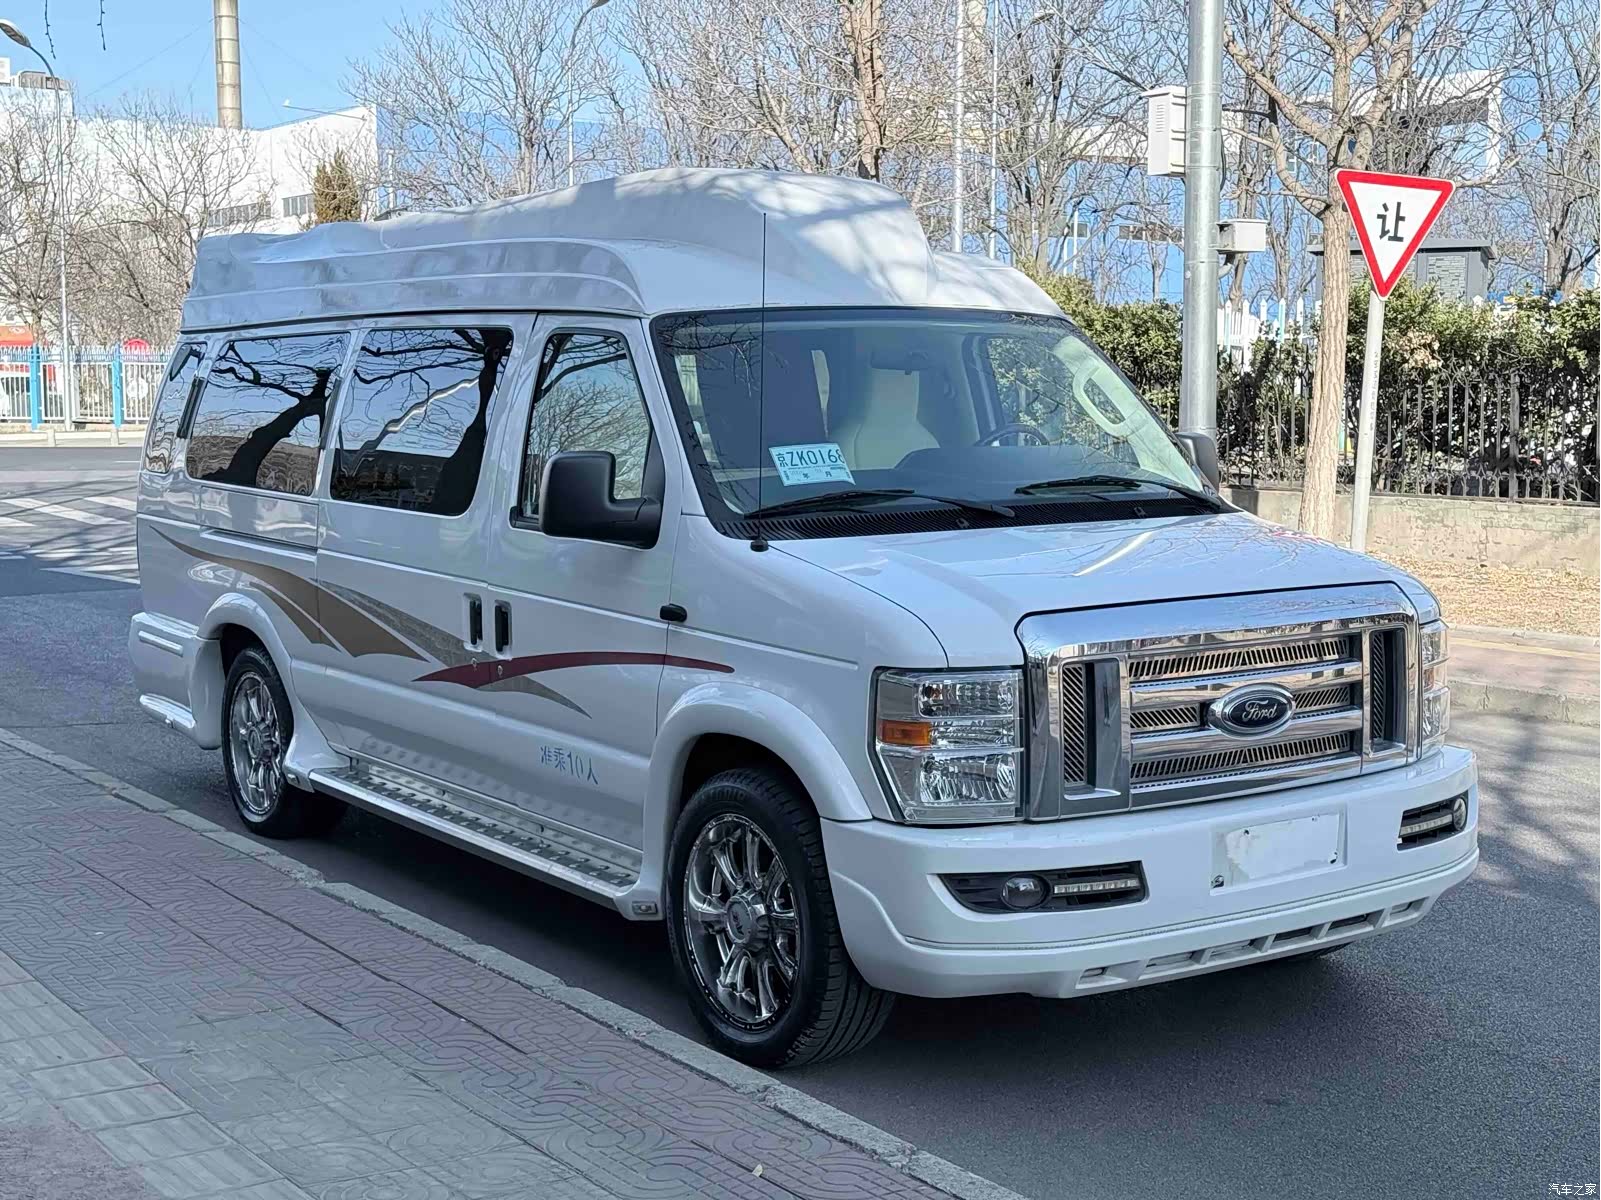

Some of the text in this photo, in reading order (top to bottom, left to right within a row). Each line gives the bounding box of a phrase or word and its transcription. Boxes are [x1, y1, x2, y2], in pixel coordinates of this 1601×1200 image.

[1377, 201, 1406, 243] 让
[1242, 699, 1278, 722] Ford
[540, 745, 599, 785] 准乘10人
